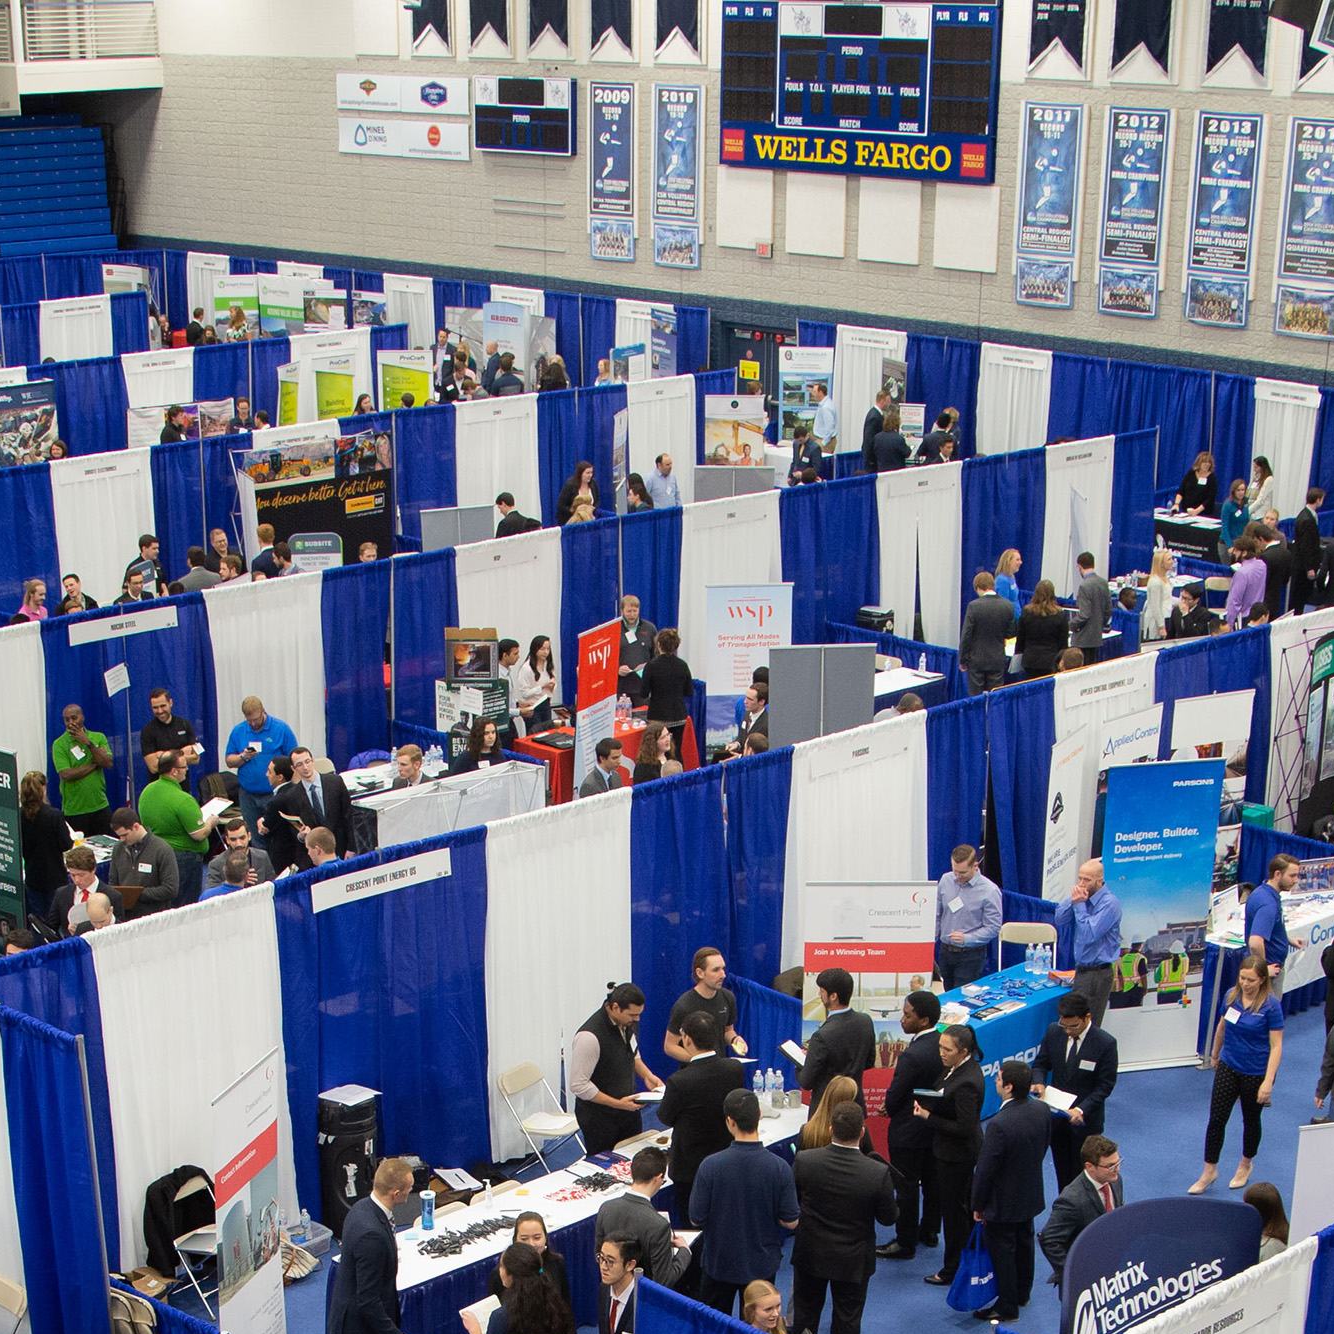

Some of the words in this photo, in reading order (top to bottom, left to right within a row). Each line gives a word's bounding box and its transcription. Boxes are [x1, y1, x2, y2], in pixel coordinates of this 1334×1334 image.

[841, 46, 863, 56] PERIOD
[785, 82, 803, 93] FOULS
[832, 84, 853, 94] PLAYER
[854, 85, 871, 95] FOUL
[900, 87, 920, 97] FOULS
[595, 90, 630, 104] 2009
[662, 91, 694, 104] 2010
[1033, 109, 1071, 122] 2011
[1118, 115, 1160, 128] 2012
[784, 116, 803, 126] SCORE
[839, 119, 861, 129] MATCH
[898, 122, 919, 132] SCORE
[1208, 120, 1252, 134] 2013
[753, 134, 847, 165] WELLS
[854, 140, 952, 172] FARGO
[1135, 724, 1160, 740] Control
[1173, 779, 1214, 787] PARSONS
[1115, 831, 1160, 842] Designer.
[1163, 827, 1199, 838] Builder.
[1114, 843, 1164, 854] Developer.
[345, 879, 372, 893] CRESCENT
[373, 876, 388, 886] POINT
[389, 869, 408, 882] ENERGY
[868, 908, 901, 917] Crescent
[835, 949, 866, 957] Winning
[1092, 1260, 1149, 1308] Matrix
[1097, 1259, 1223, 1334] Technologies
[1213, 1308, 1245, 1334] RESOURCES
